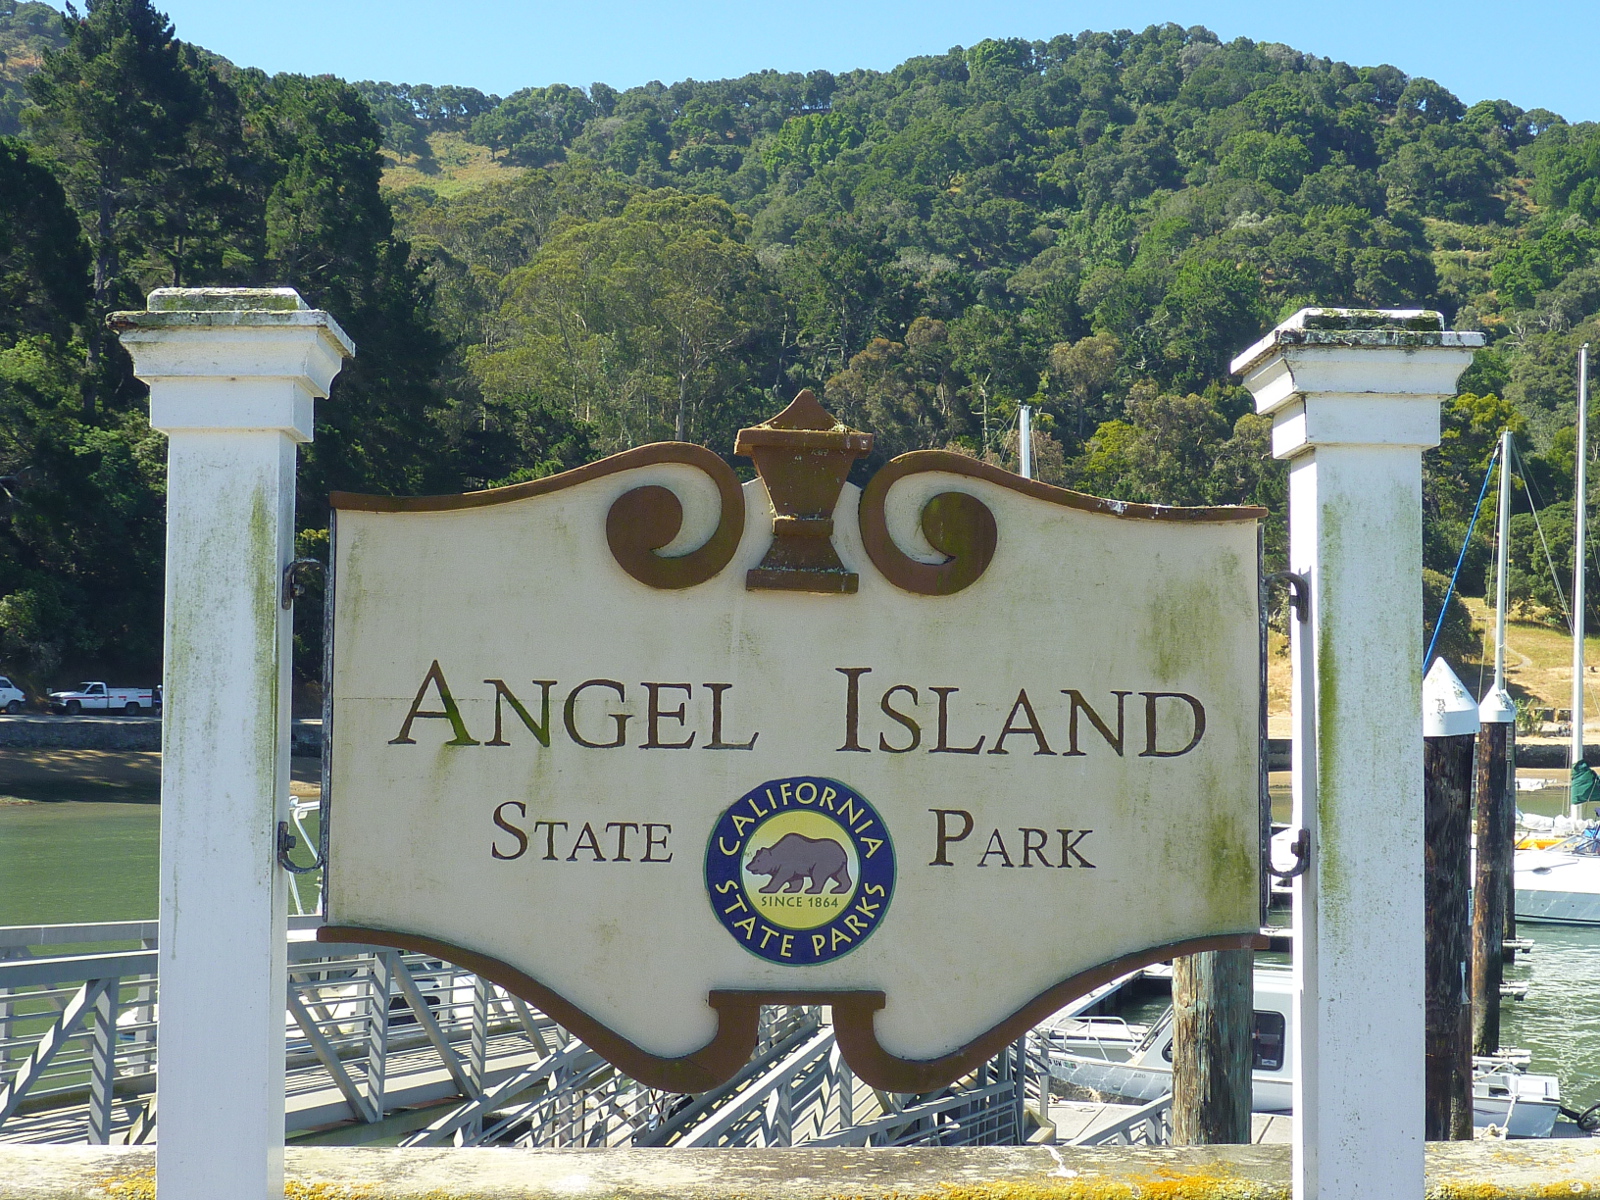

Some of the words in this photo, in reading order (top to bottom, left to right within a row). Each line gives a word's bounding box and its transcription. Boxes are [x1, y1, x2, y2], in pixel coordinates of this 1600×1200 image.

[388, 659, 759, 750] ANGEL
[835, 667, 1206, 758] ISLAND
[492, 801, 674, 863] STATE
[928, 808, 1096, 869] PARK
[719, 782, 884, 859] CALIFORNIA
[715, 879, 795, 957] STATE
[811, 882, 885, 956] PARKS
[761, 896, 803, 907] SINCE
[807, 897, 839, 908] 1864
